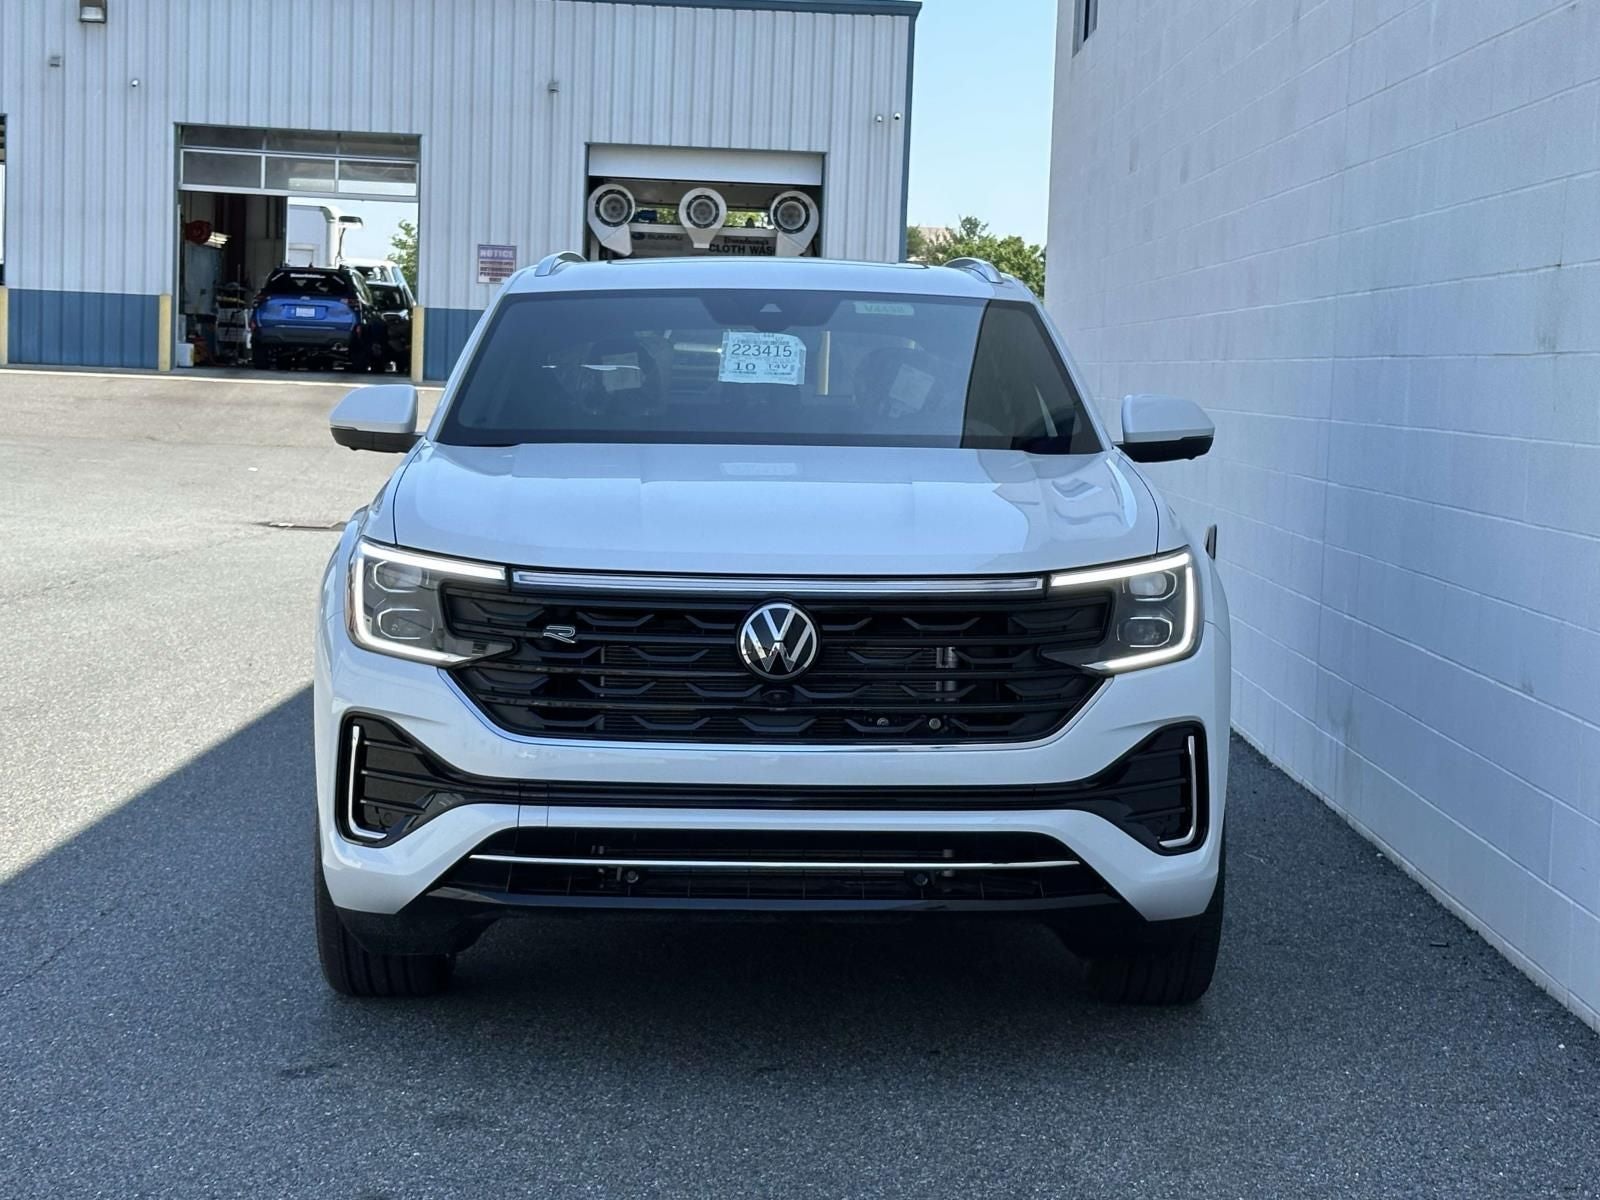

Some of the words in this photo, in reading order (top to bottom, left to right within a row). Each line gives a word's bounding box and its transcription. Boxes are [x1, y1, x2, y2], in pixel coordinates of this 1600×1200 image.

[709, 243, 746, 253] CLOTH
[480, 249, 514, 258] NOTICE
[730, 343, 792, 358] 223415
